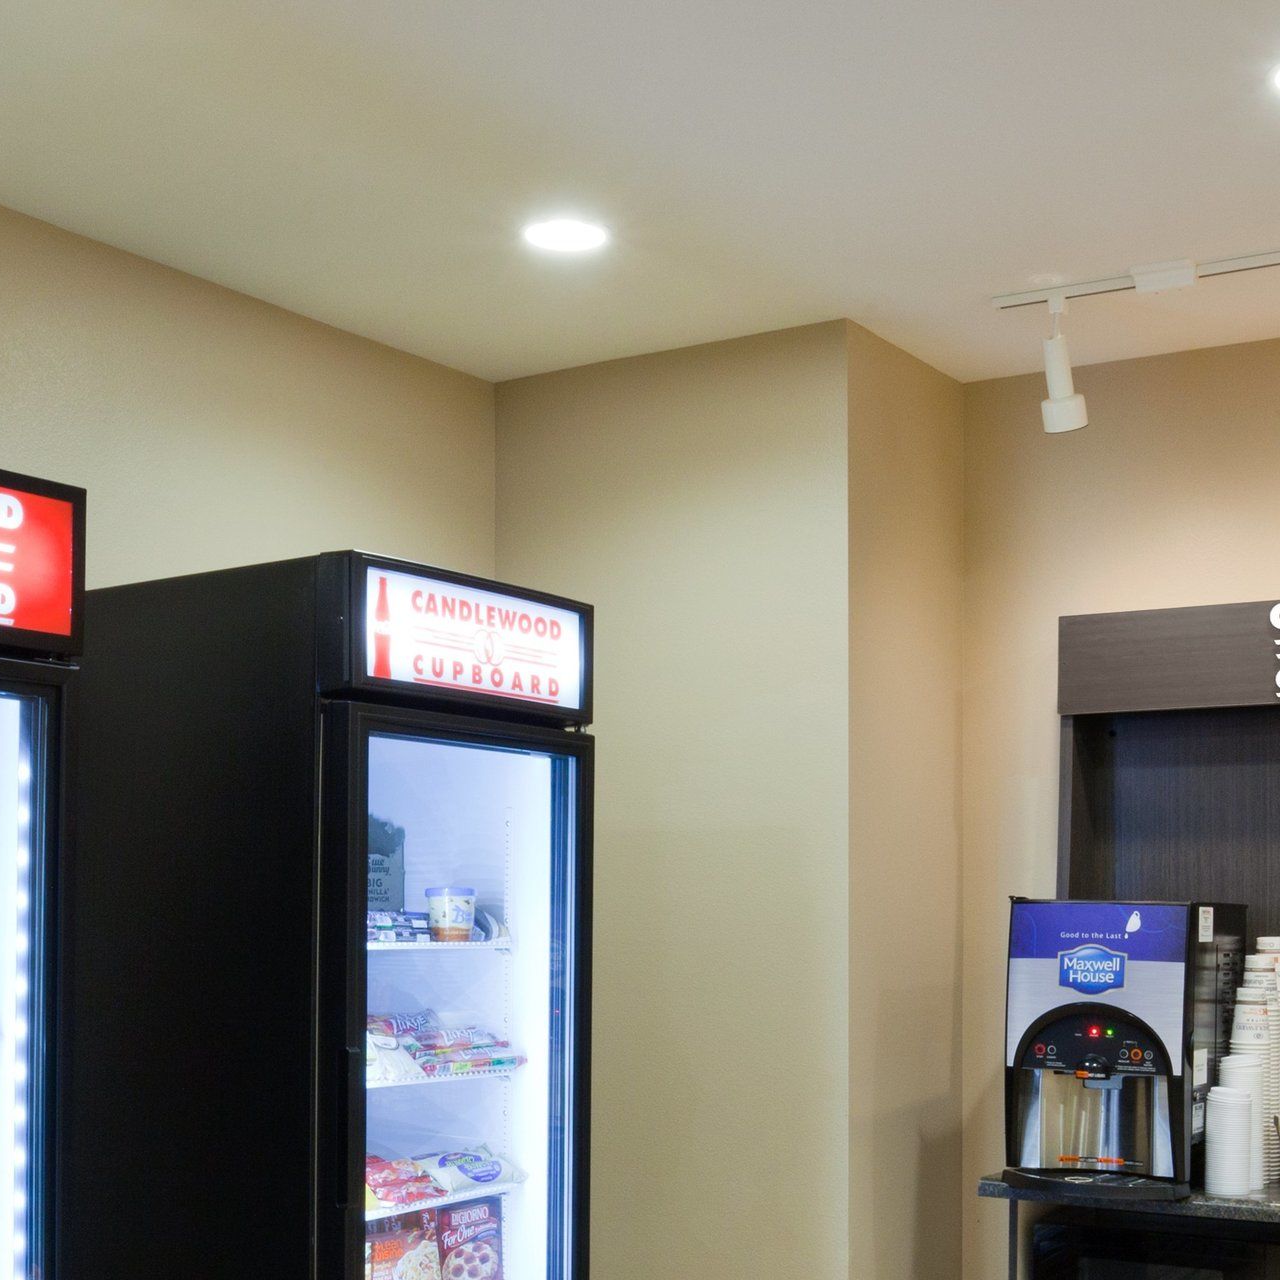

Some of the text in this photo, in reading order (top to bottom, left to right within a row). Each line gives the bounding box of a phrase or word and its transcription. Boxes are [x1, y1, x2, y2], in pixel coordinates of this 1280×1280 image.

[411, 589, 562, 641] CANDLEWOOD
[412, 654, 560, 697] CUPBOARD
[1060, 931, 1080, 939] Good
[1091, 931, 1104, 939] the
[1105, 932, 1122, 940] Last
[1063, 957, 1121, 972] Maxwell
[1069, 970, 1115, 983] House
